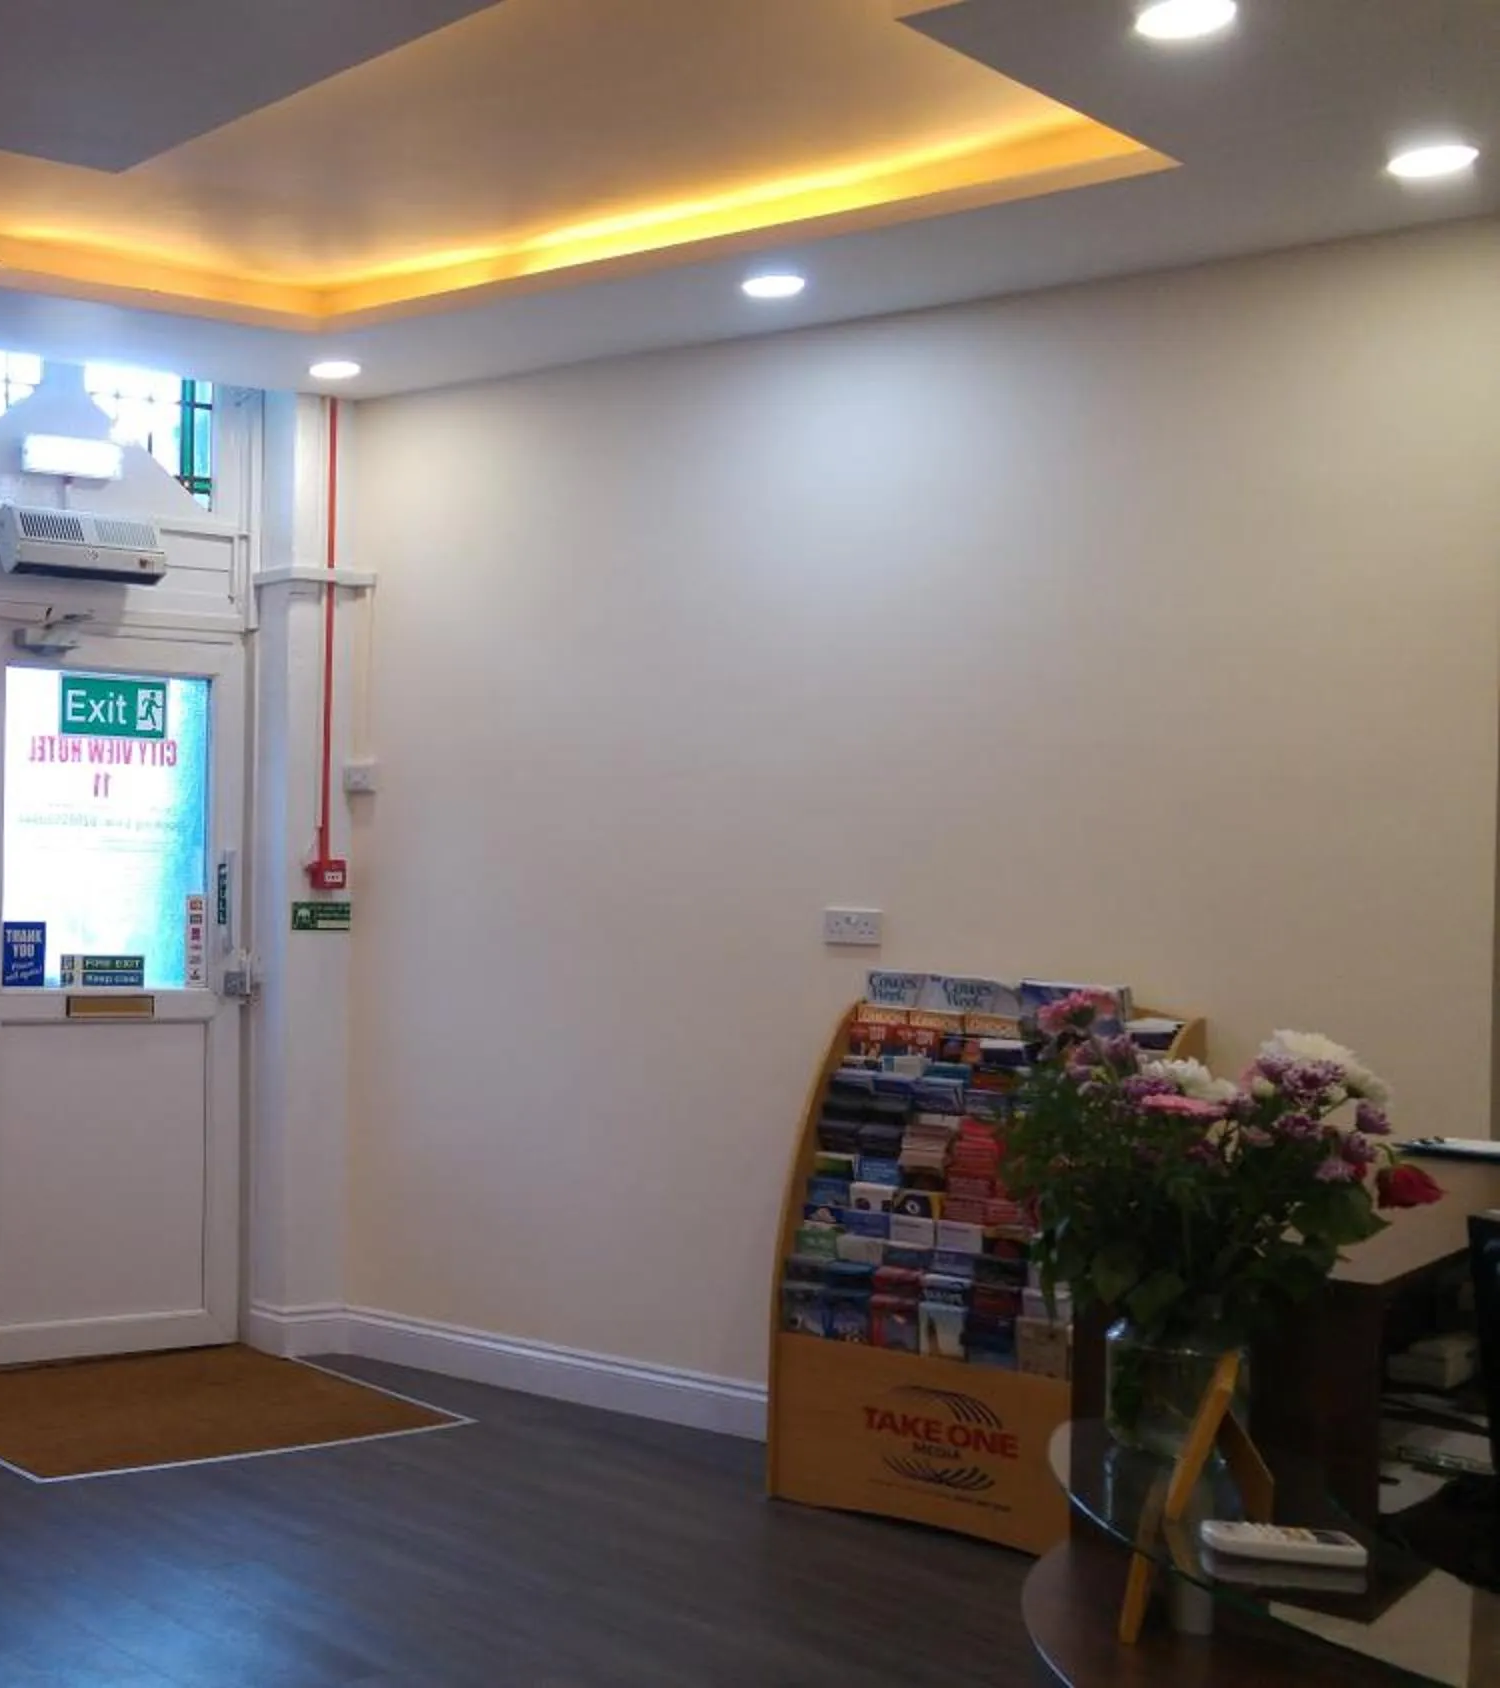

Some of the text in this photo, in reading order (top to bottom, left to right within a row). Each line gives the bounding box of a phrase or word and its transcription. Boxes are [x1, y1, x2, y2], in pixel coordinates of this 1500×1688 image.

[66, 689, 128, 725] Exit
[5, 929, 43, 943] THANK
[13, 943, 35, 958] YOU
[115, 959, 141, 969] EXIT
[863, 1406, 1020, 1460] TAKE ONE
[911, 1440, 962, 1461] MEDIA
